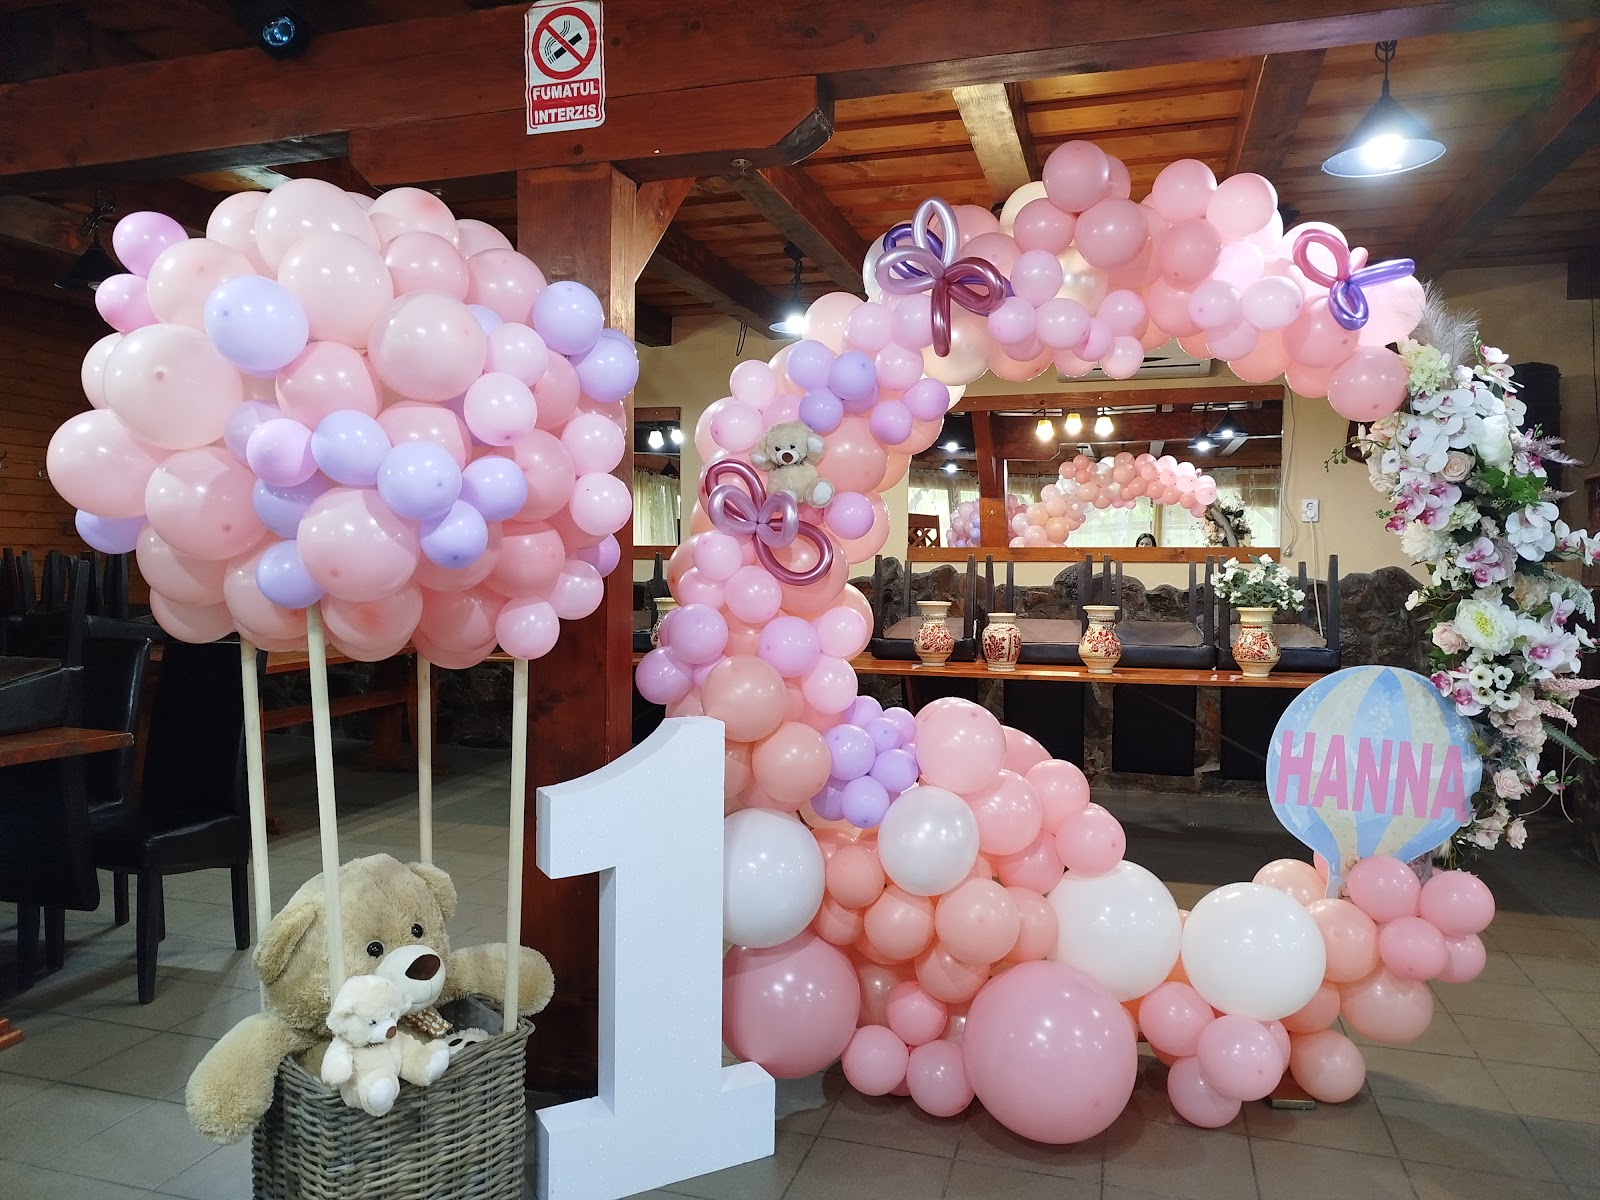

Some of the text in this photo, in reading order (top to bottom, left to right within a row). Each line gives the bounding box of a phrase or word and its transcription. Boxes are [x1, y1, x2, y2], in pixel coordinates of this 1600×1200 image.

[532, 81, 599, 100] FUMATUL
[534, 104, 597, 124] INTERZIS
[1275, 730, 1467, 822] HANNA
[535, 716, 776, 1200] 1
